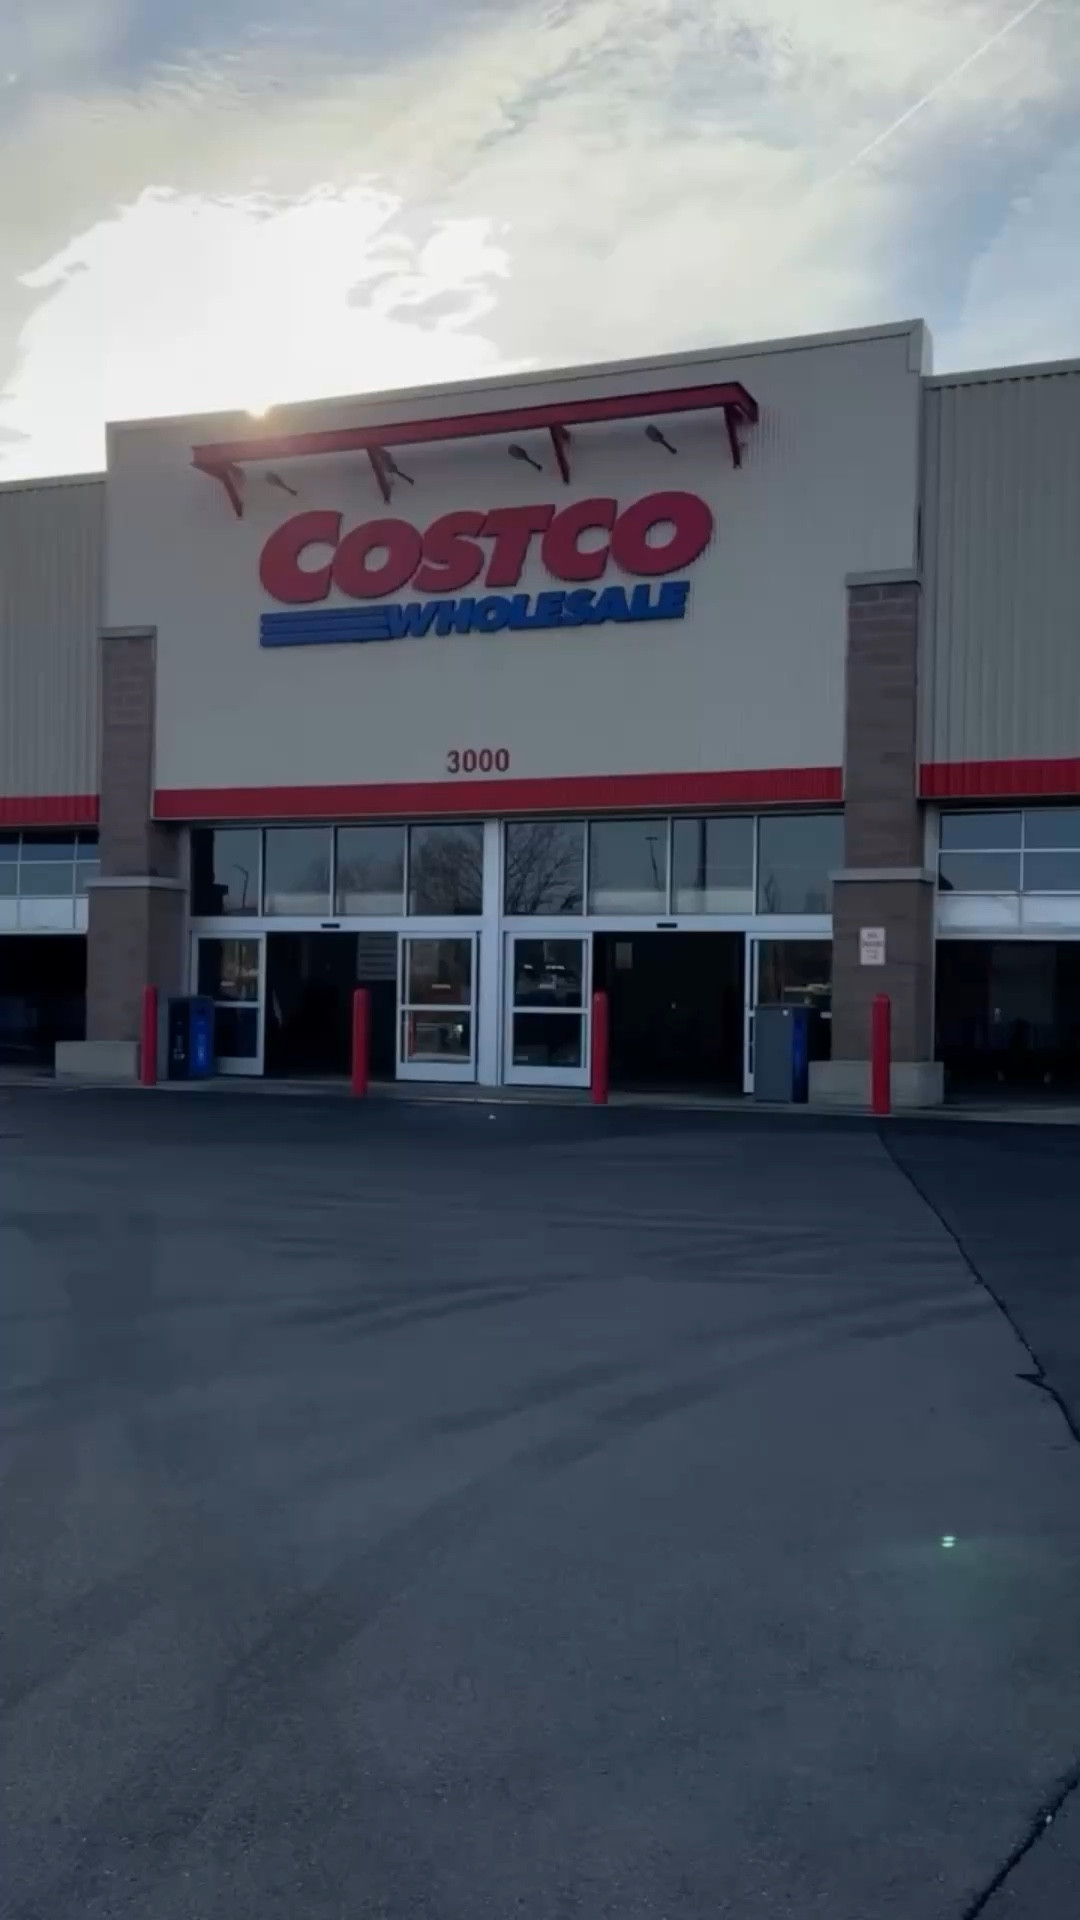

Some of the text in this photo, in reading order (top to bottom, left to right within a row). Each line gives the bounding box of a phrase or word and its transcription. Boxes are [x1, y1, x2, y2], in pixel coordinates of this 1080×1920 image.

[258, 491, 714, 604] COSTCO
[384, 580, 690, 638] WHOLESALE
[447, 748, 509, 774] 3000
